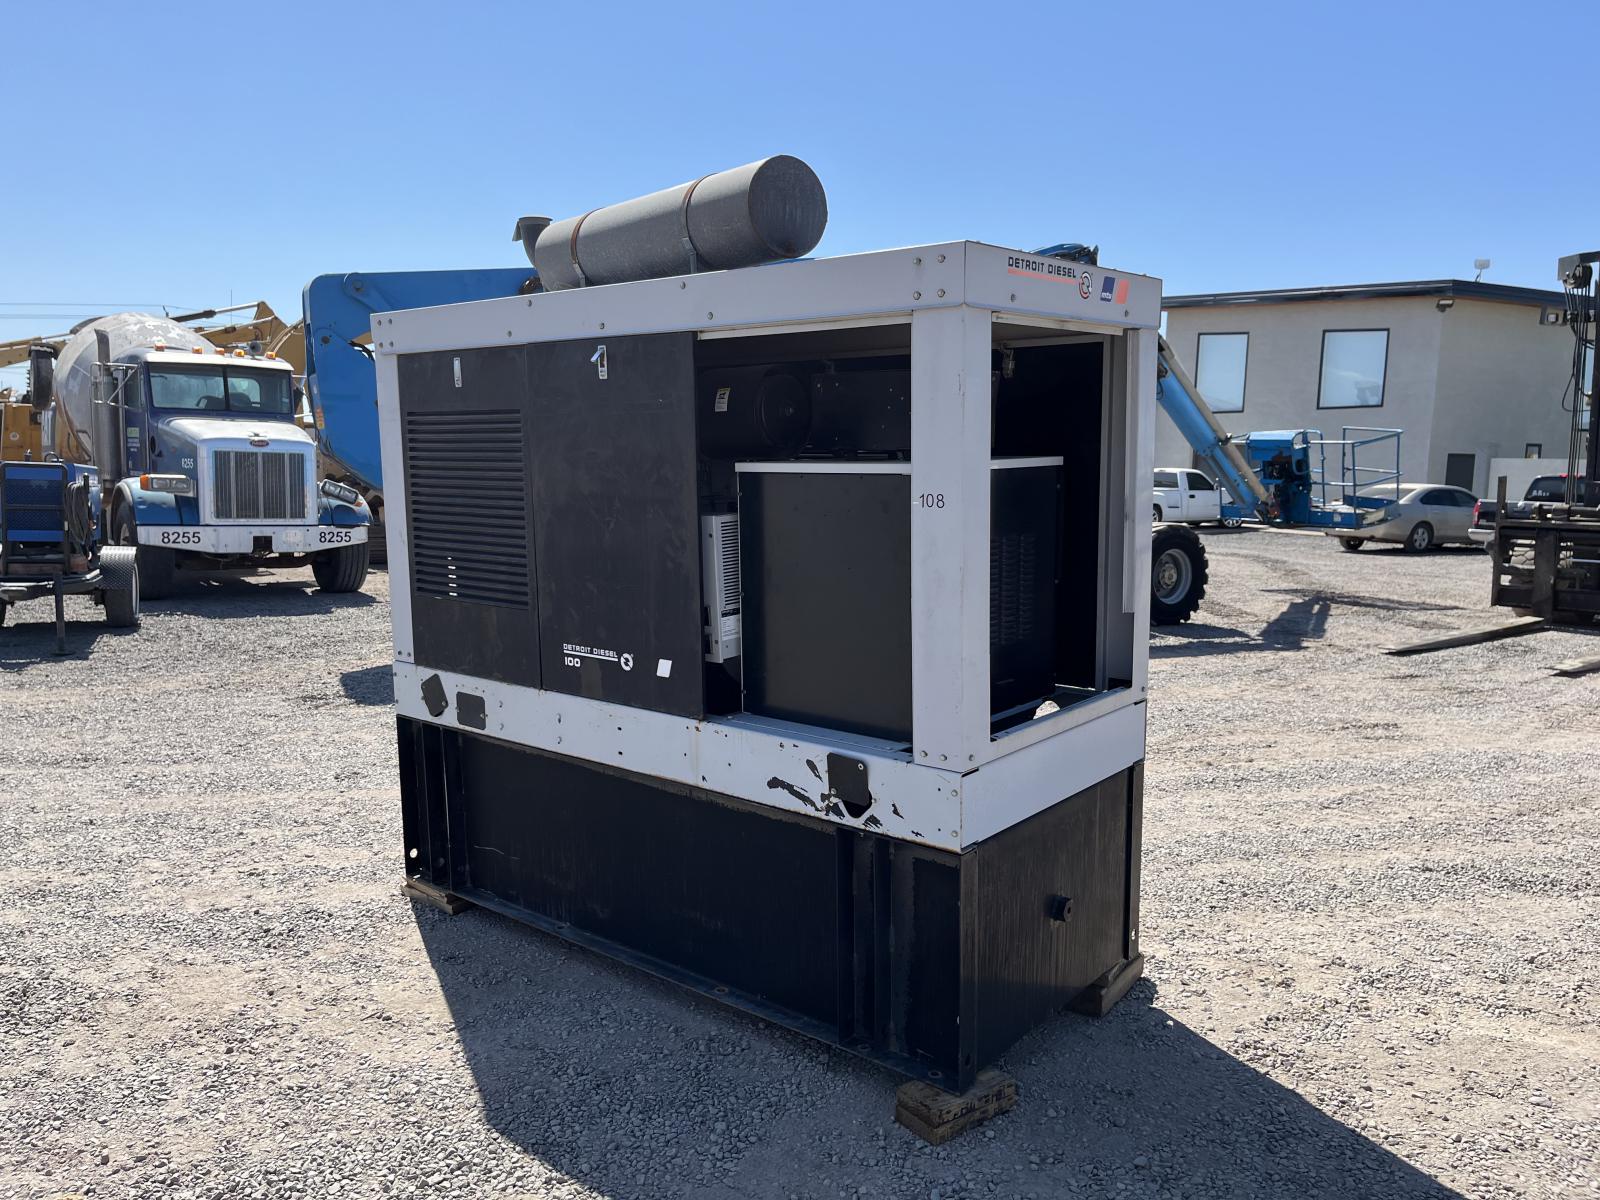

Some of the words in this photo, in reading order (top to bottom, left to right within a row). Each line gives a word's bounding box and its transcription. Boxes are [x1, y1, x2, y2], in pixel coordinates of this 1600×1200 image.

[1008, 256, 1044, 272] DETROIT
[1048, 264, 1076, 278] DIESEL
[919, 493, 945, 508] 108
[161, 531, 201, 544] 8255
[319, 531, 351, 543] 8255
[563, 643, 591, 653] DETROIT
[593, 648, 618, 658] DIESEL
[564, 656, 581, 667] 100
